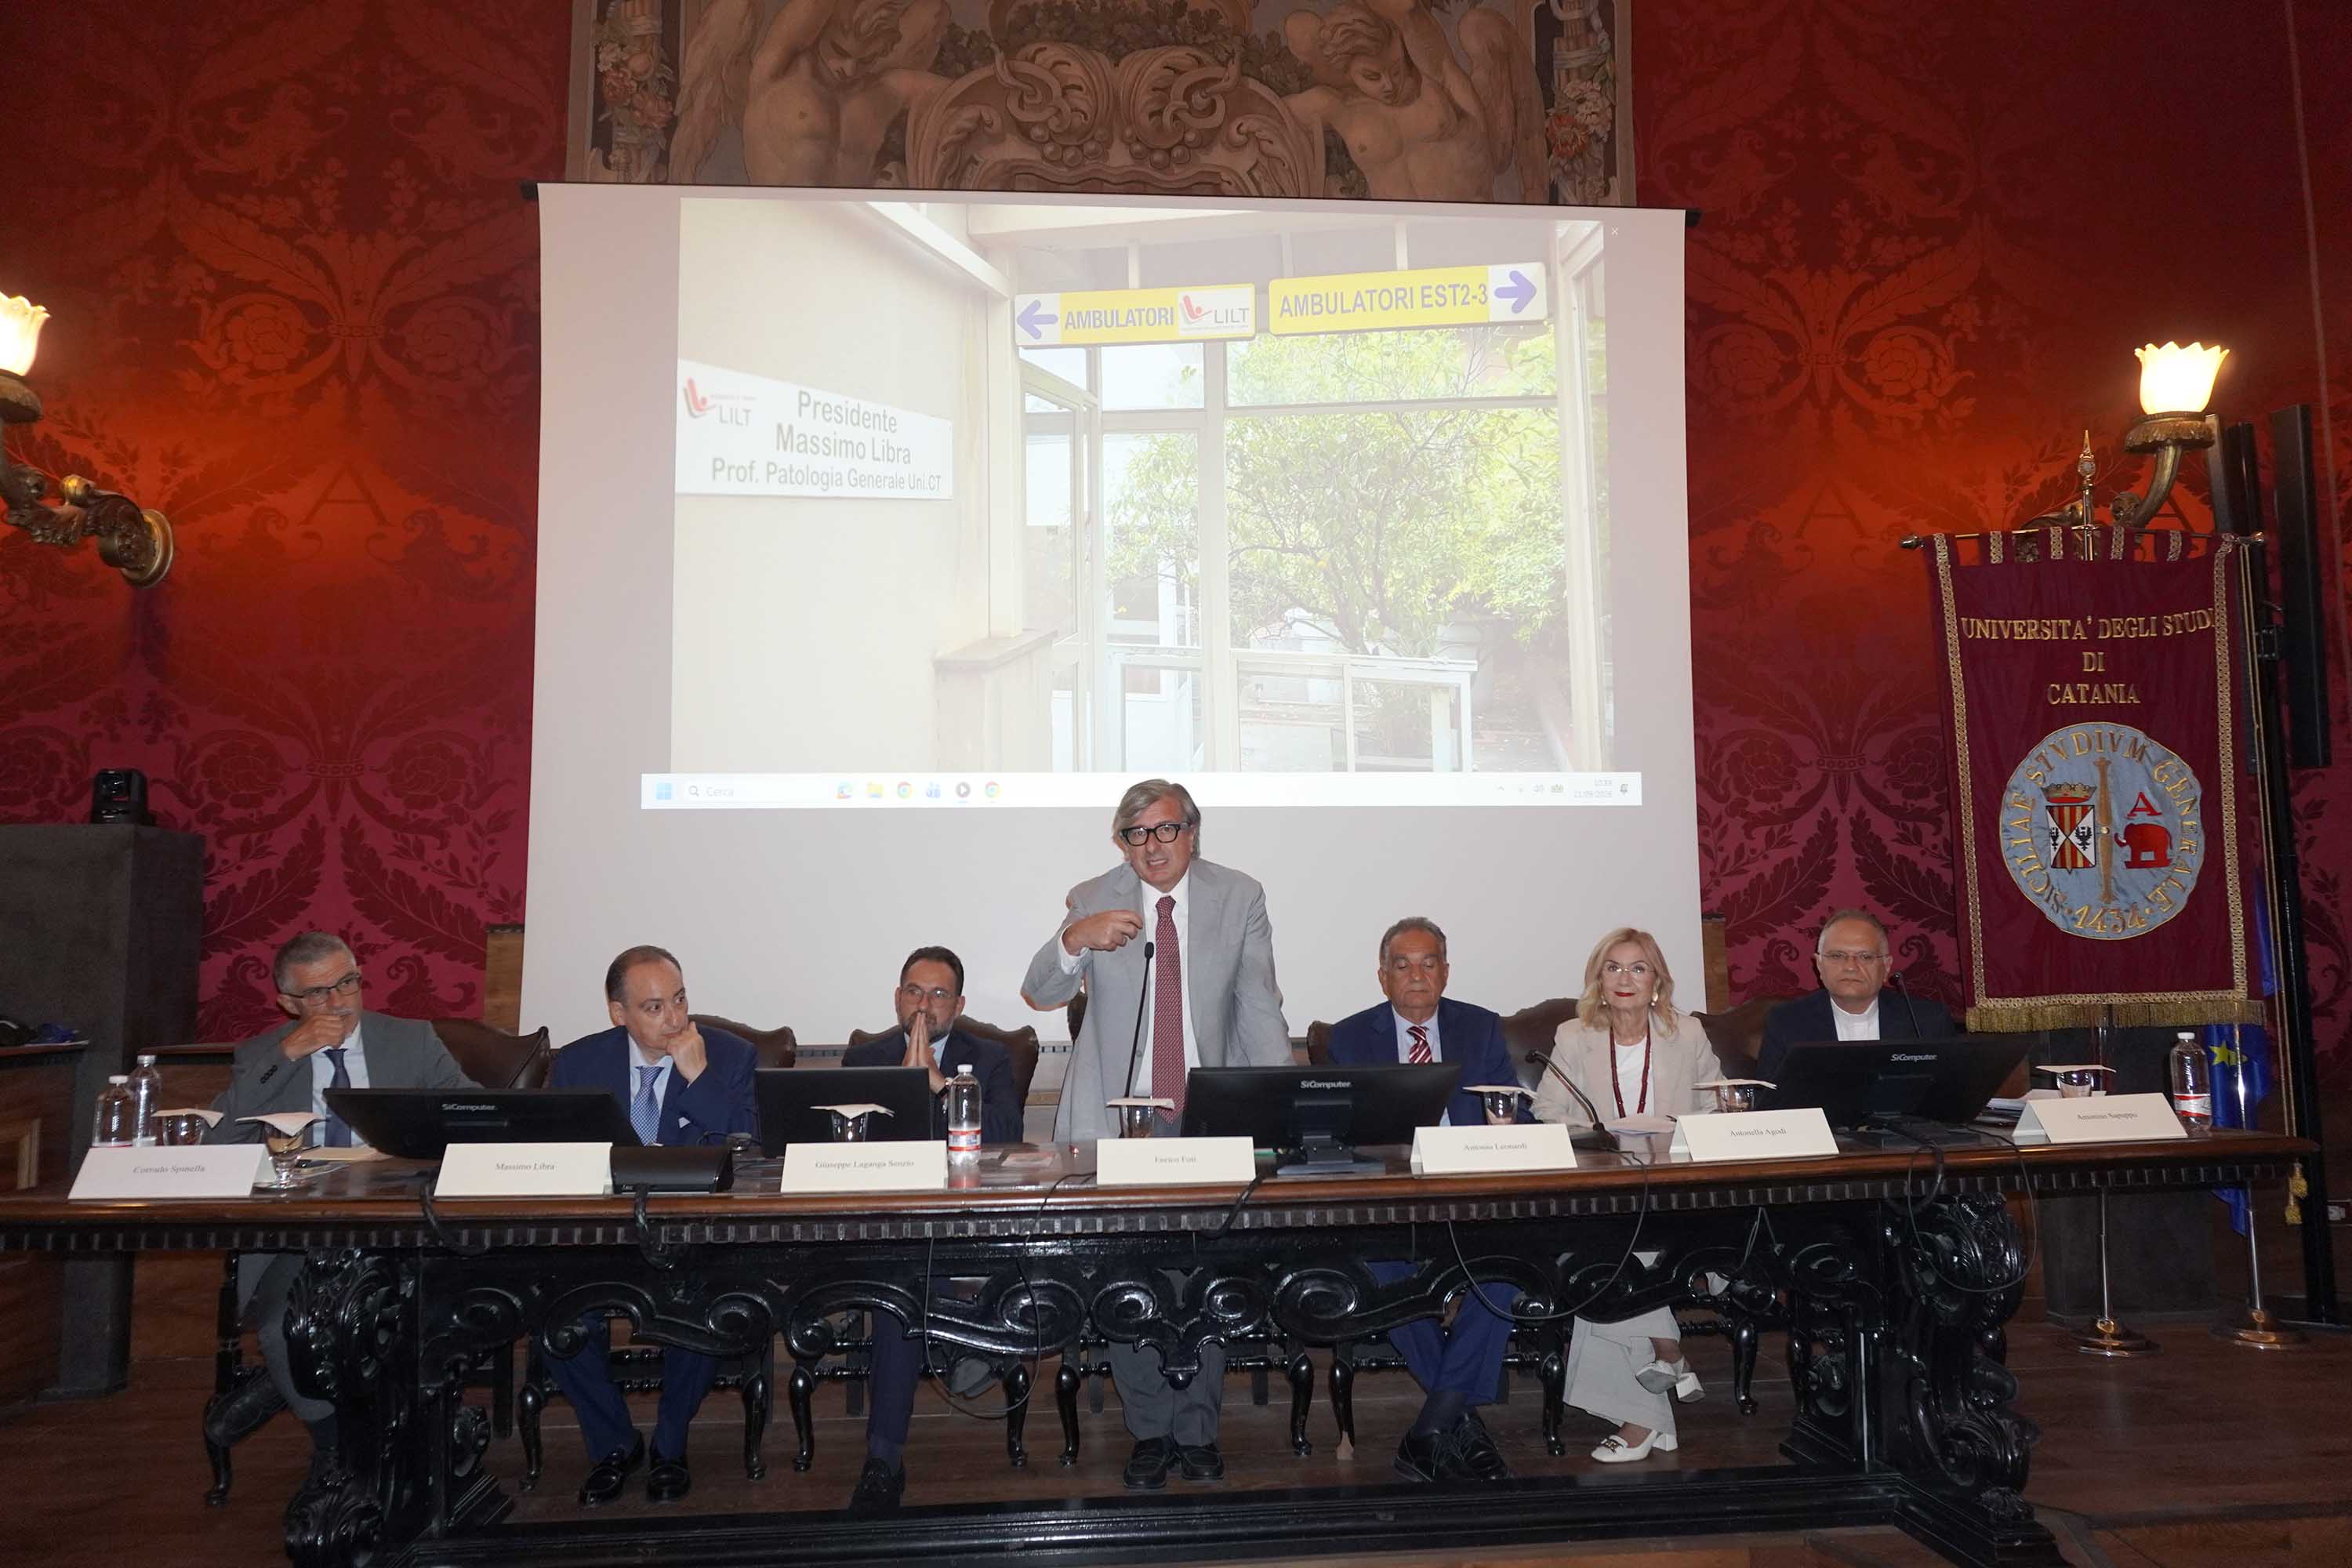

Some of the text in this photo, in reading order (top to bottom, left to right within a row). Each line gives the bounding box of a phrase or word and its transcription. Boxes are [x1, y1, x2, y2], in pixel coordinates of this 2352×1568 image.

[1279, 279, 1489, 318] AMBULATORI EST2-3
[1064, 307, 1250, 331] AMBULATORI LILT
[719, 405, 753, 427] LILT
[797, 390, 898, 433] Presidente
[775, 423, 912, 465] Massimo Libra
[711, 456, 760, 484] Prof.
[765, 461, 844, 492] Patologia
[847, 468, 906, 490] Generale
[2098, 616, 2158, 639] DEGLI
[2082, 652, 2106, 672] DI
[2047, 684, 2141, 704] CATANIA
[2127, 791, 2162, 820] A
[2074, 902, 2147, 934] 1434
[1890, 1053, 1937, 1062] SiComputer
[1300, 1080, 1352, 1090] SiComputer
[441, 1103, 496, 1112] SiComputer
[1730, 1127, 1788, 1138] Antonella Agodi
[495, 1162, 555, 1171] Massimo Libra
[815, 1160, 851, 1170] Giuseppe
